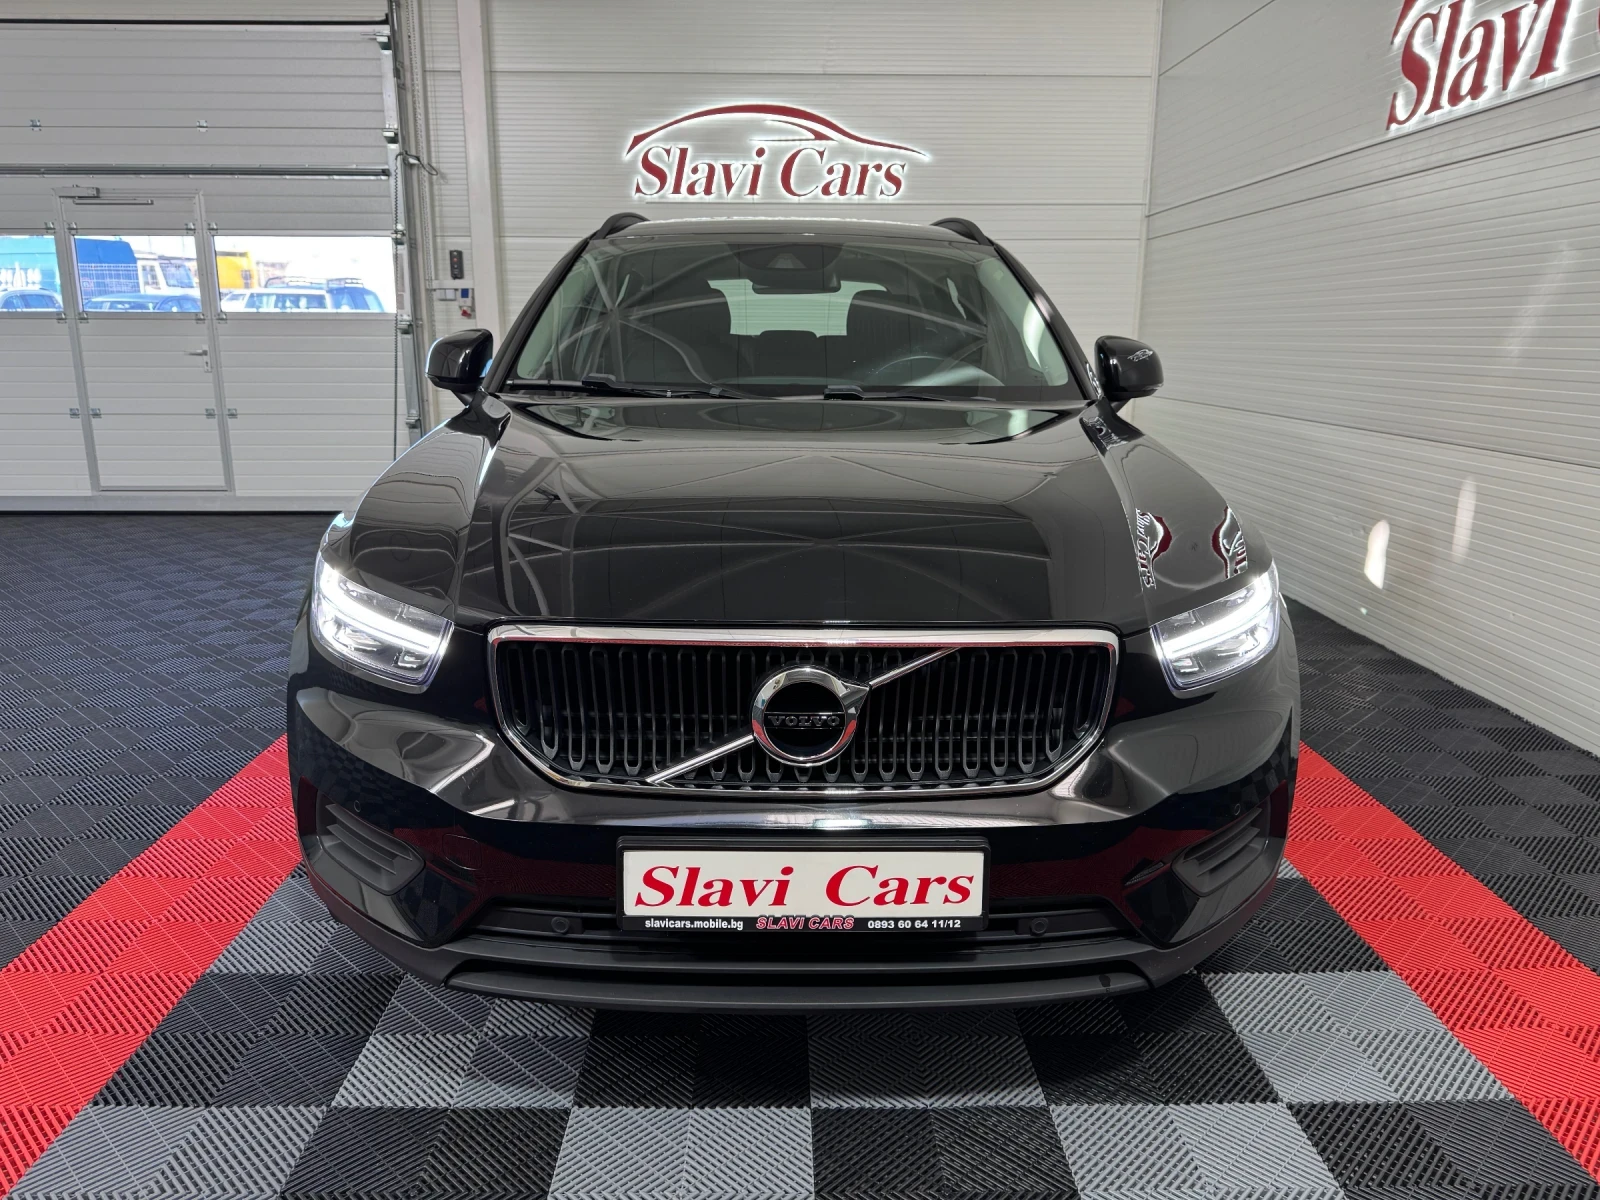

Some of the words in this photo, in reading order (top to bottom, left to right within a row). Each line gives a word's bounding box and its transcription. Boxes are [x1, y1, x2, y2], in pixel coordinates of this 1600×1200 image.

[634, 146, 766, 197] Slavi
[780, 147, 907, 197] Cars
[768, 715, 841, 727] VOLVO
[634, 866, 795, 907] Slavi
[825, 865, 975, 906] Cars
[645, 918, 744, 931] slavicars.mobile.bg
[756, 917, 805, 930] SLAVI
[808, 917, 855, 930] CARS
[867, 920, 895, 929] 0893
[897, 920, 912, 929] 60
[914, 920, 928, 929] 64
[931, 919, 961, 928] 11/12
